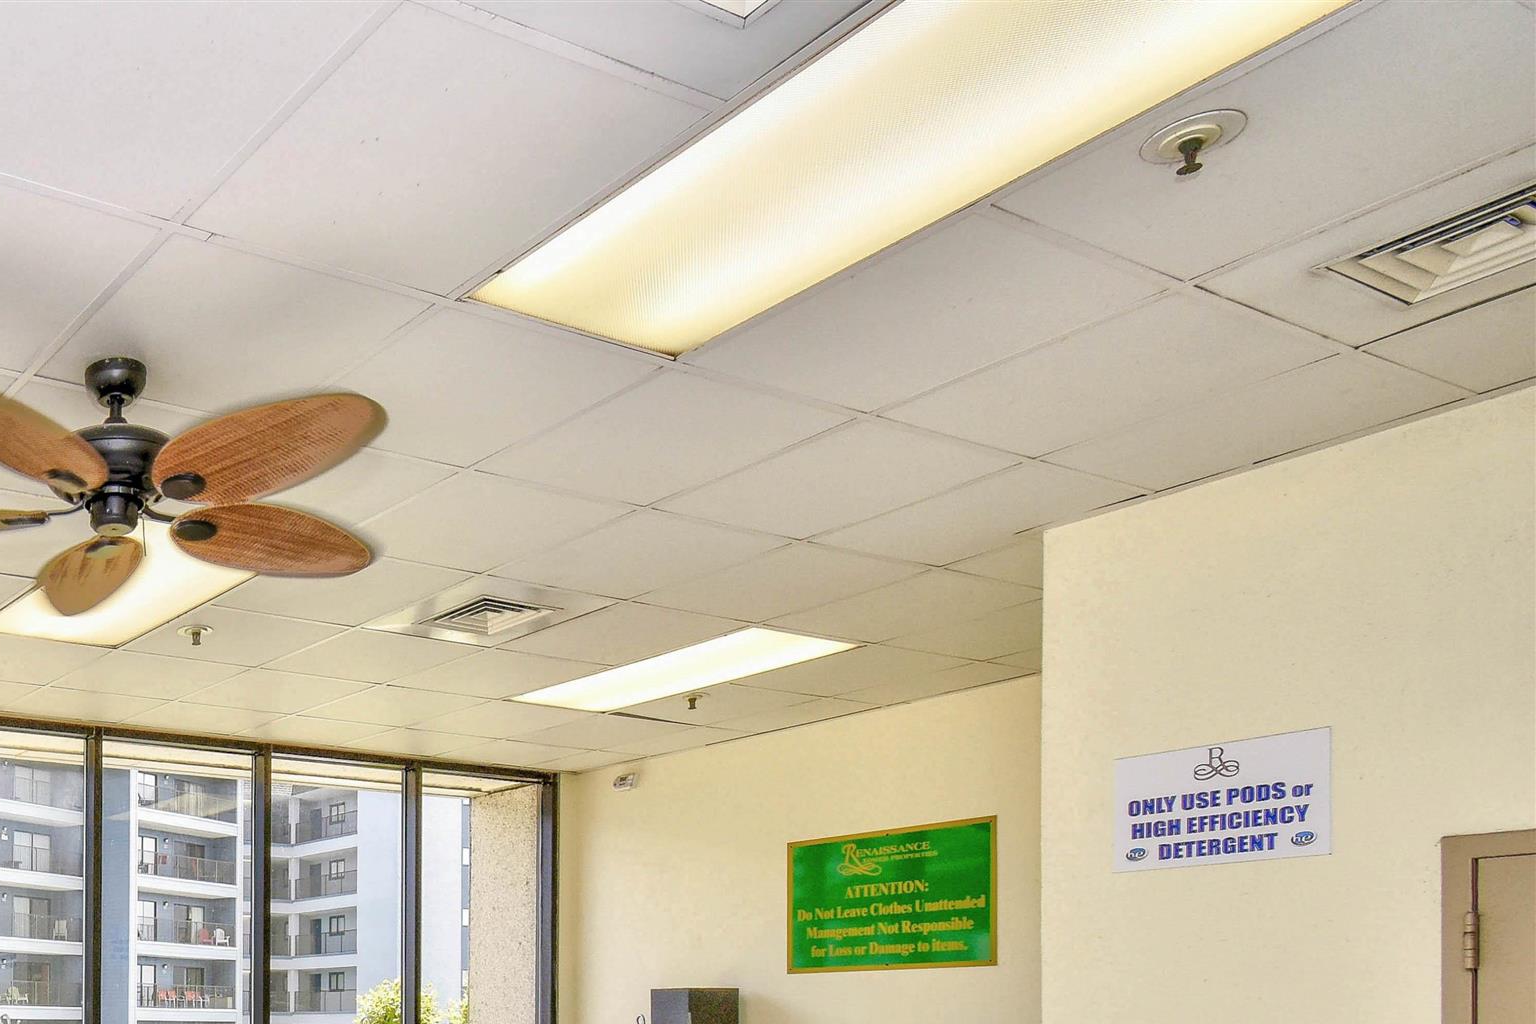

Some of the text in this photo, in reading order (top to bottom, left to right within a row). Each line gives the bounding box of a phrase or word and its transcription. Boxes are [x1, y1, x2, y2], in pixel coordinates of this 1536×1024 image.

[1127, 781, 1314, 817] ONLY USE PODS or
[1131, 803, 1310, 840] HIGH EFFICIENCY
[841, 841, 931, 866] RENAISSANCE
[1158, 832, 1279, 861] DETERGENT
[845, 879, 929, 899] ATTENTION:
[797, 894, 986, 922] Do Not Leave Clothes Unattended
[806, 917, 975, 940] Management Not Responsible
[811, 945, 826, 958] for
[829, 944, 852, 957] Loss
[854, 946, 867, 956] or
[869, 941, 916, 956] Damage
[917, 940, 930, 952] to
